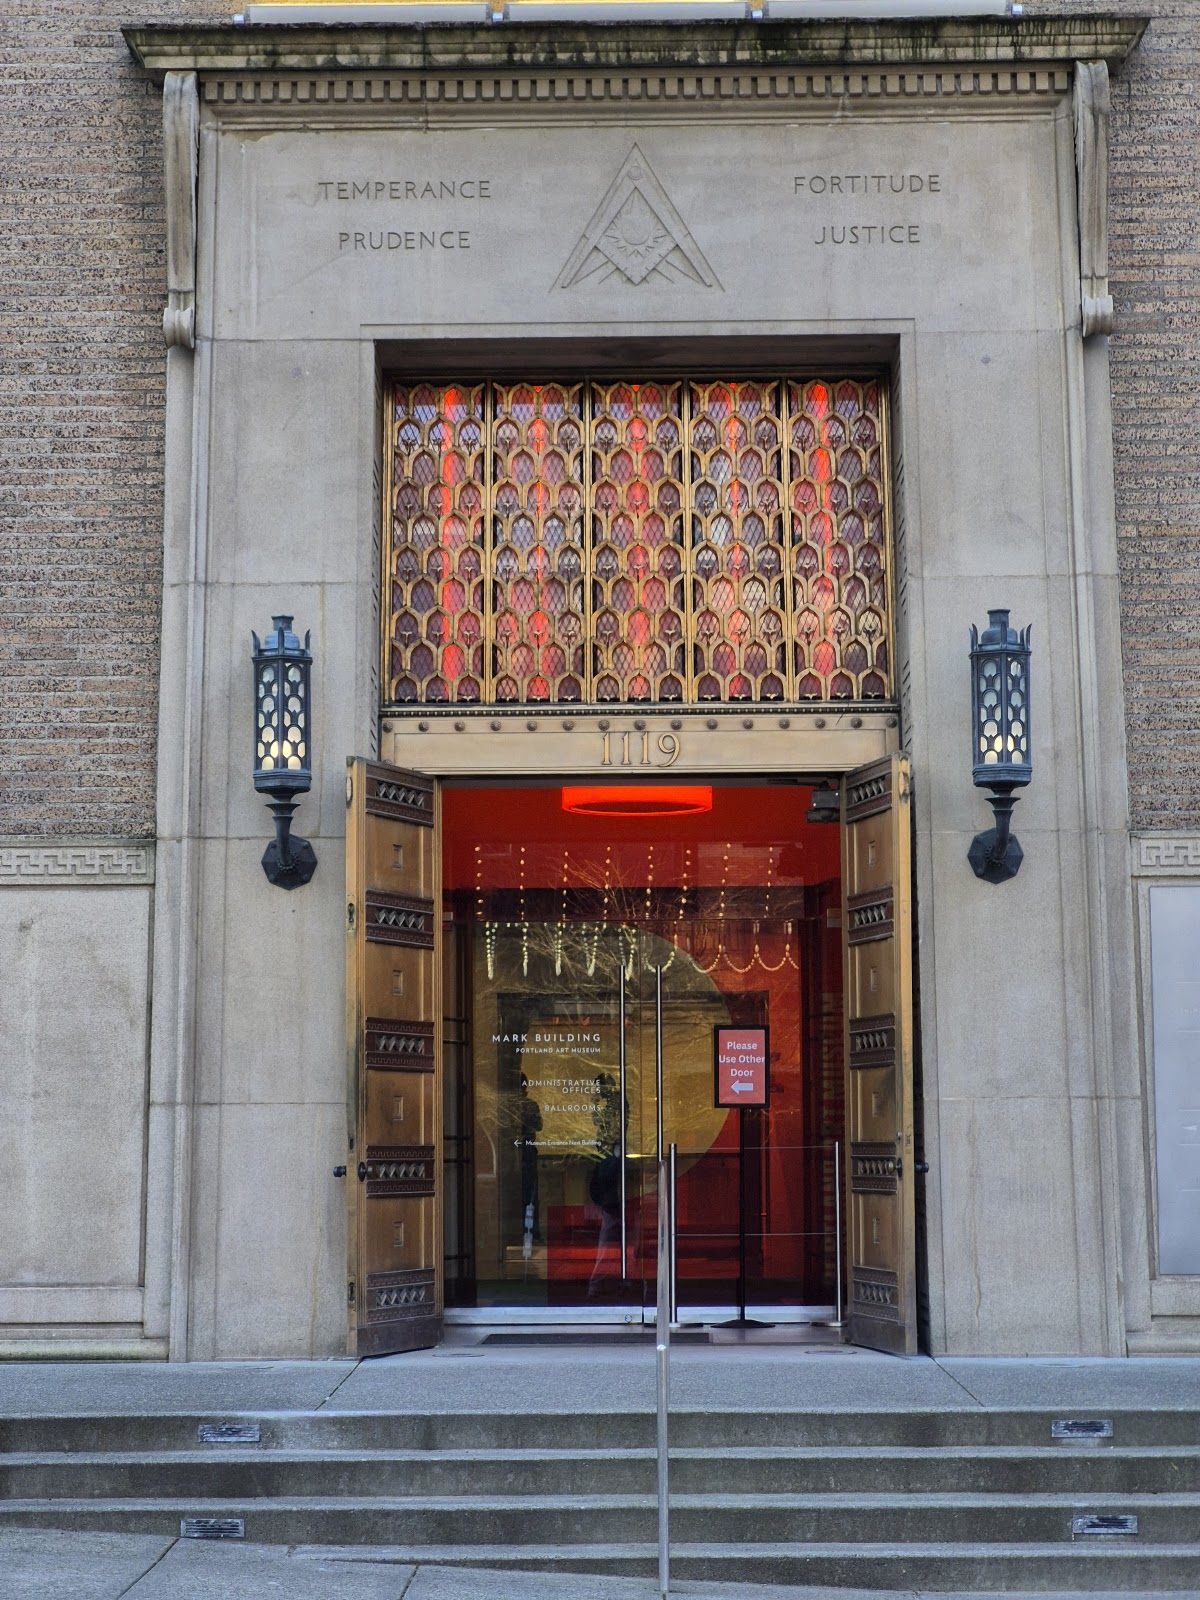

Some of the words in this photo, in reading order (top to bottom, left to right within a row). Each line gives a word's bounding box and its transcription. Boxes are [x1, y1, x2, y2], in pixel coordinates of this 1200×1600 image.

[794, 174, 941, 195] FORTITUDE
[318, 180, 491, 200] TEMPERANCE
[814, 225, 920, 245] JUSTICE
[338, 231, 471, 250] PRUDENCE
[601, 731, 680, 767] 1119
[492, 1033, 528, 1043] MARK
[535, 1033, 601, 1042] BUILDING
[726, 1041, 758, 1050] Please
[719, 1055, 737, 1064] Use
[738, 1054, 766, 1064] Other
[730, 1068, 754, 1077] Door
[521, 1079, 601, 1087] ADMINISTRATIVE
[562, 1086, 601, 1094] OFFICES
[544, 1104, 601, 1112] BALLROOMS
